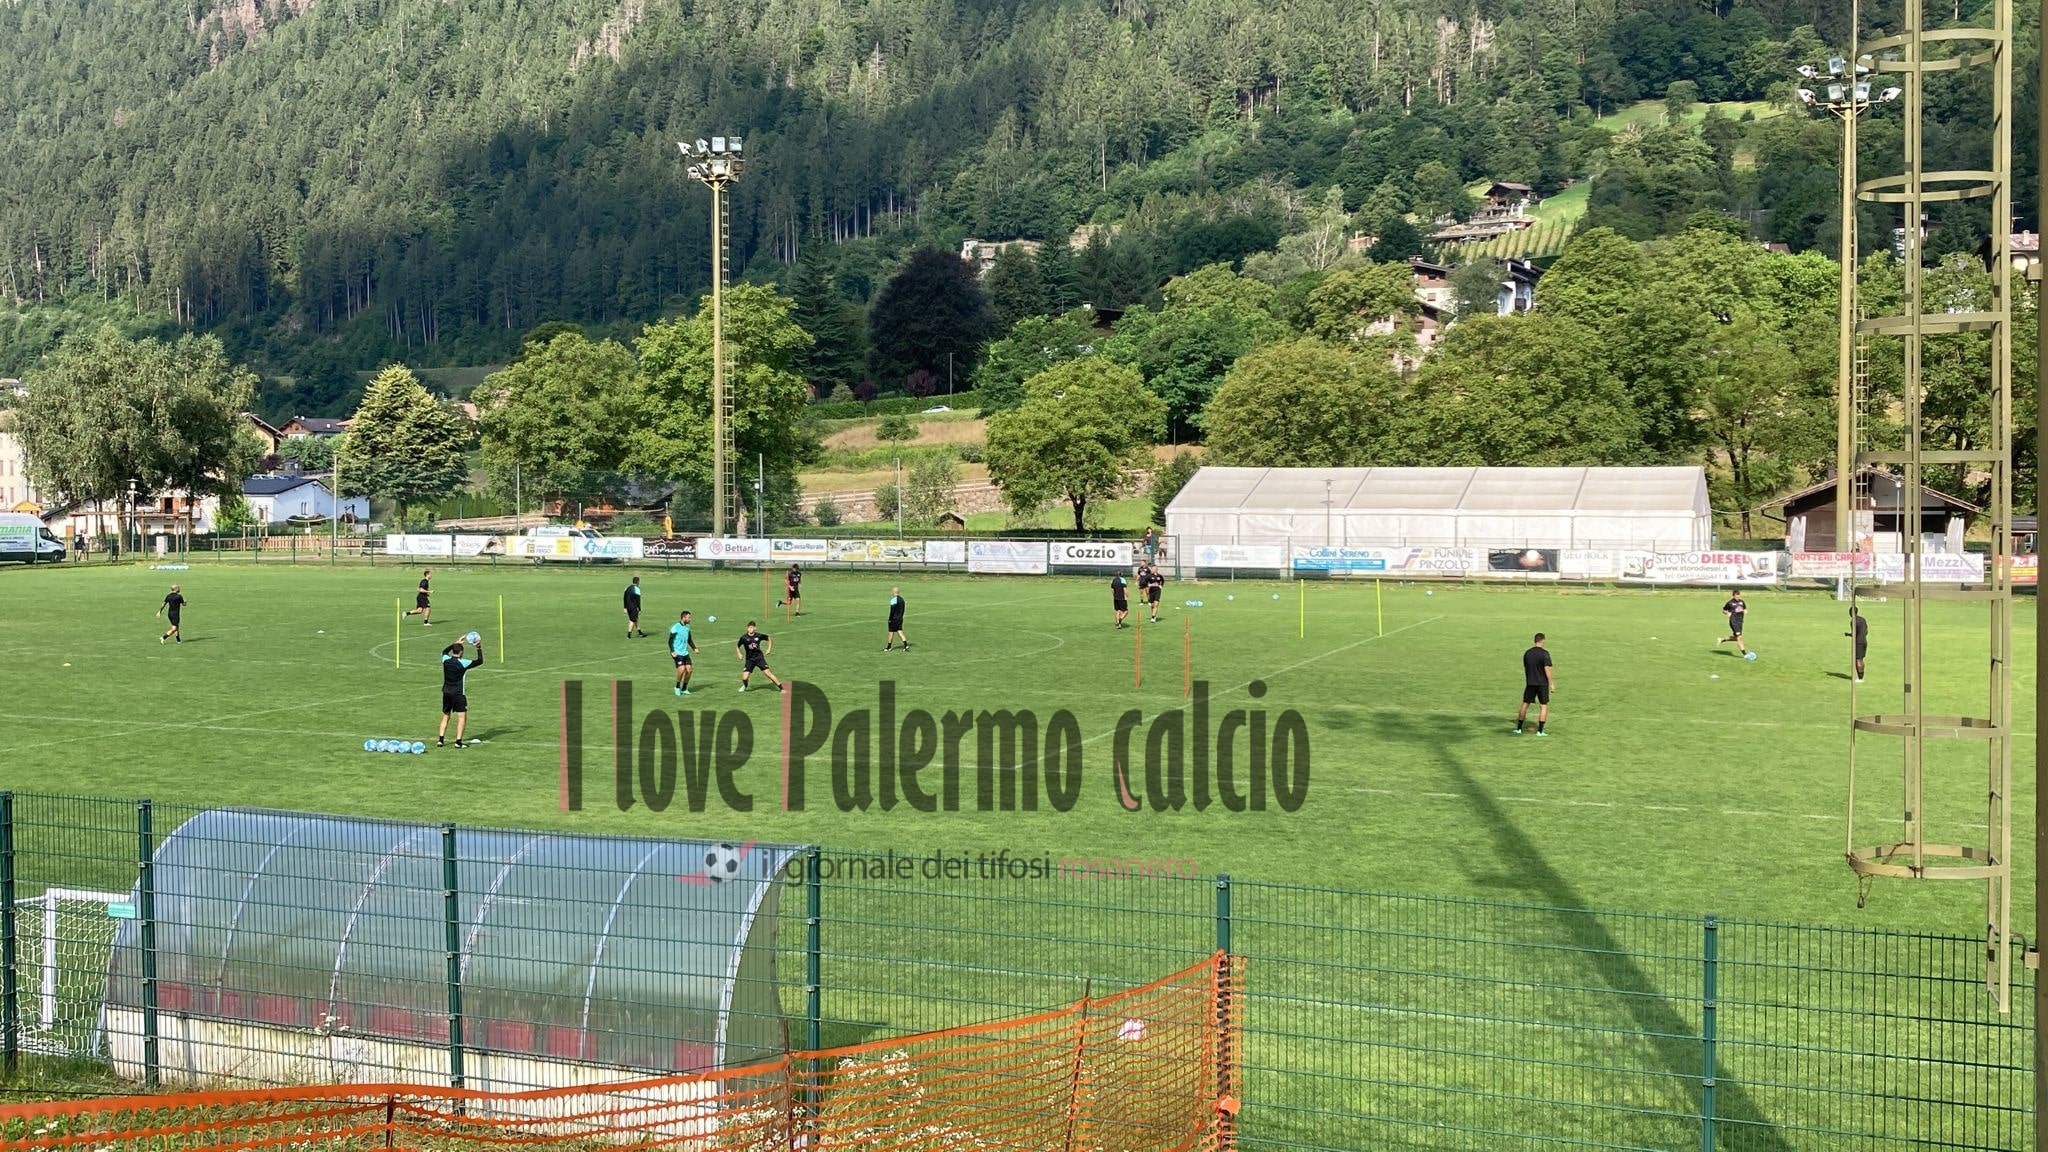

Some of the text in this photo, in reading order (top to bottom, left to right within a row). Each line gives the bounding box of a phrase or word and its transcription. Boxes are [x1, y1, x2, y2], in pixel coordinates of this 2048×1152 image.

[725, 543, 753, 552] Bettari
[1066, 545, 1116, 559] Cozzio
[1419, 559, 1470, 570] PINZOLO
[1655, 553, 1749, 565] STORO DIESEL
[1924, 556, 1963, 568] Mezzi
